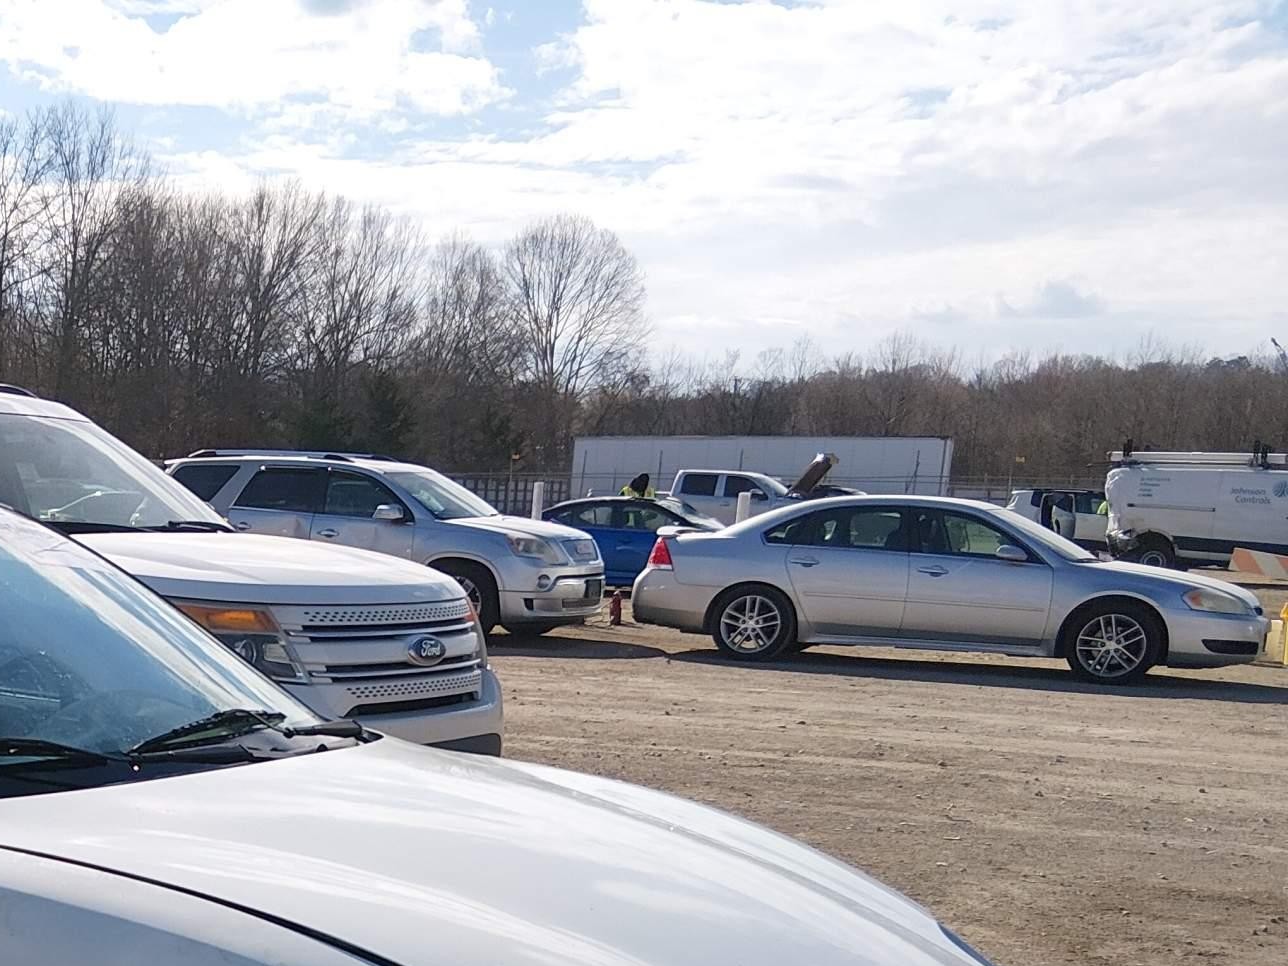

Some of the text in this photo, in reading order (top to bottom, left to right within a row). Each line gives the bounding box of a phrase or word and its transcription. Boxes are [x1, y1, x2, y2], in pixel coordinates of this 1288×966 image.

[1230, 487, 1266, 496] Johnson
[1235, 496, 1272, 505] Controls
[421, 640, 441, 657] Ford
